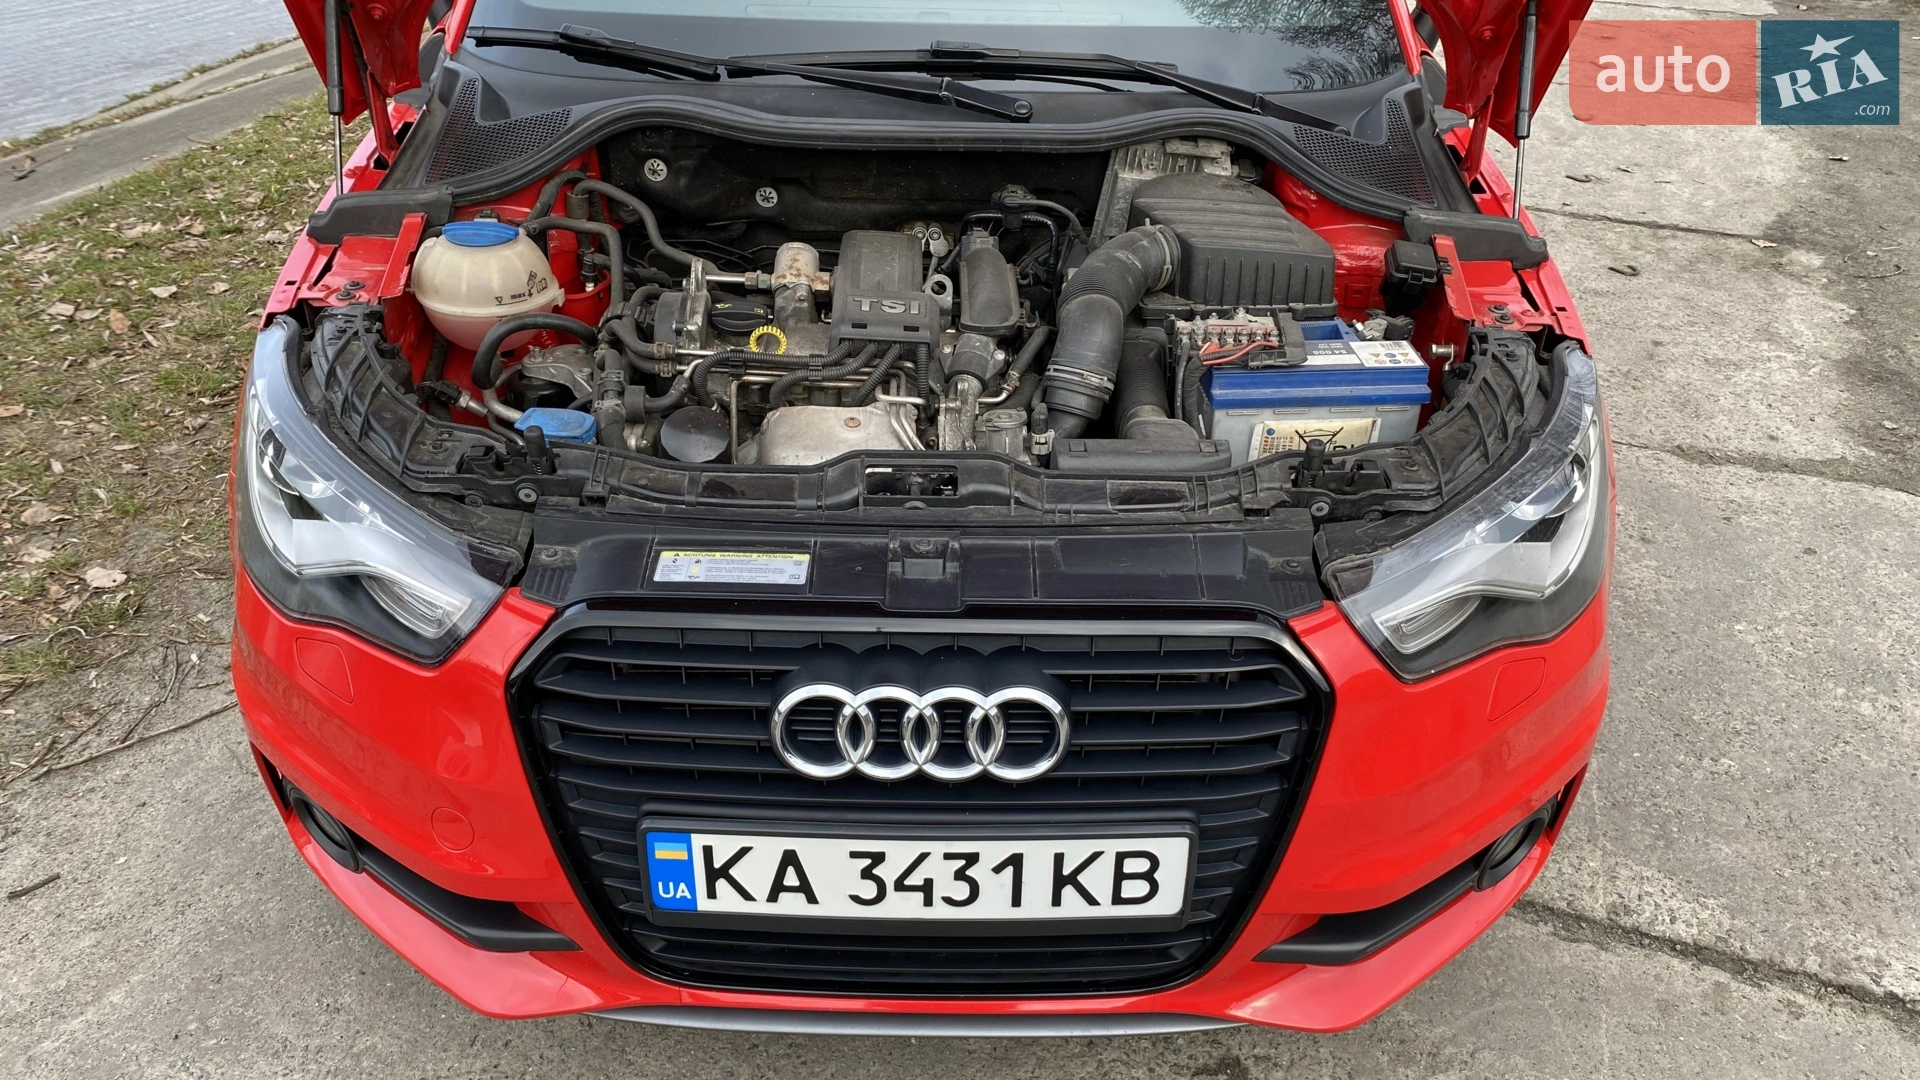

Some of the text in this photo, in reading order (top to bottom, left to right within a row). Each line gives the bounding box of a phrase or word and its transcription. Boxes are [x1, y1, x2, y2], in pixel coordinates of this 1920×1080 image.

[510, 292, 526, 300] max
[853, 298, 919, 314] TSI
[701, 845, 1161, 908] KA 3431 KB
[657, 882, 692, 899] UA
